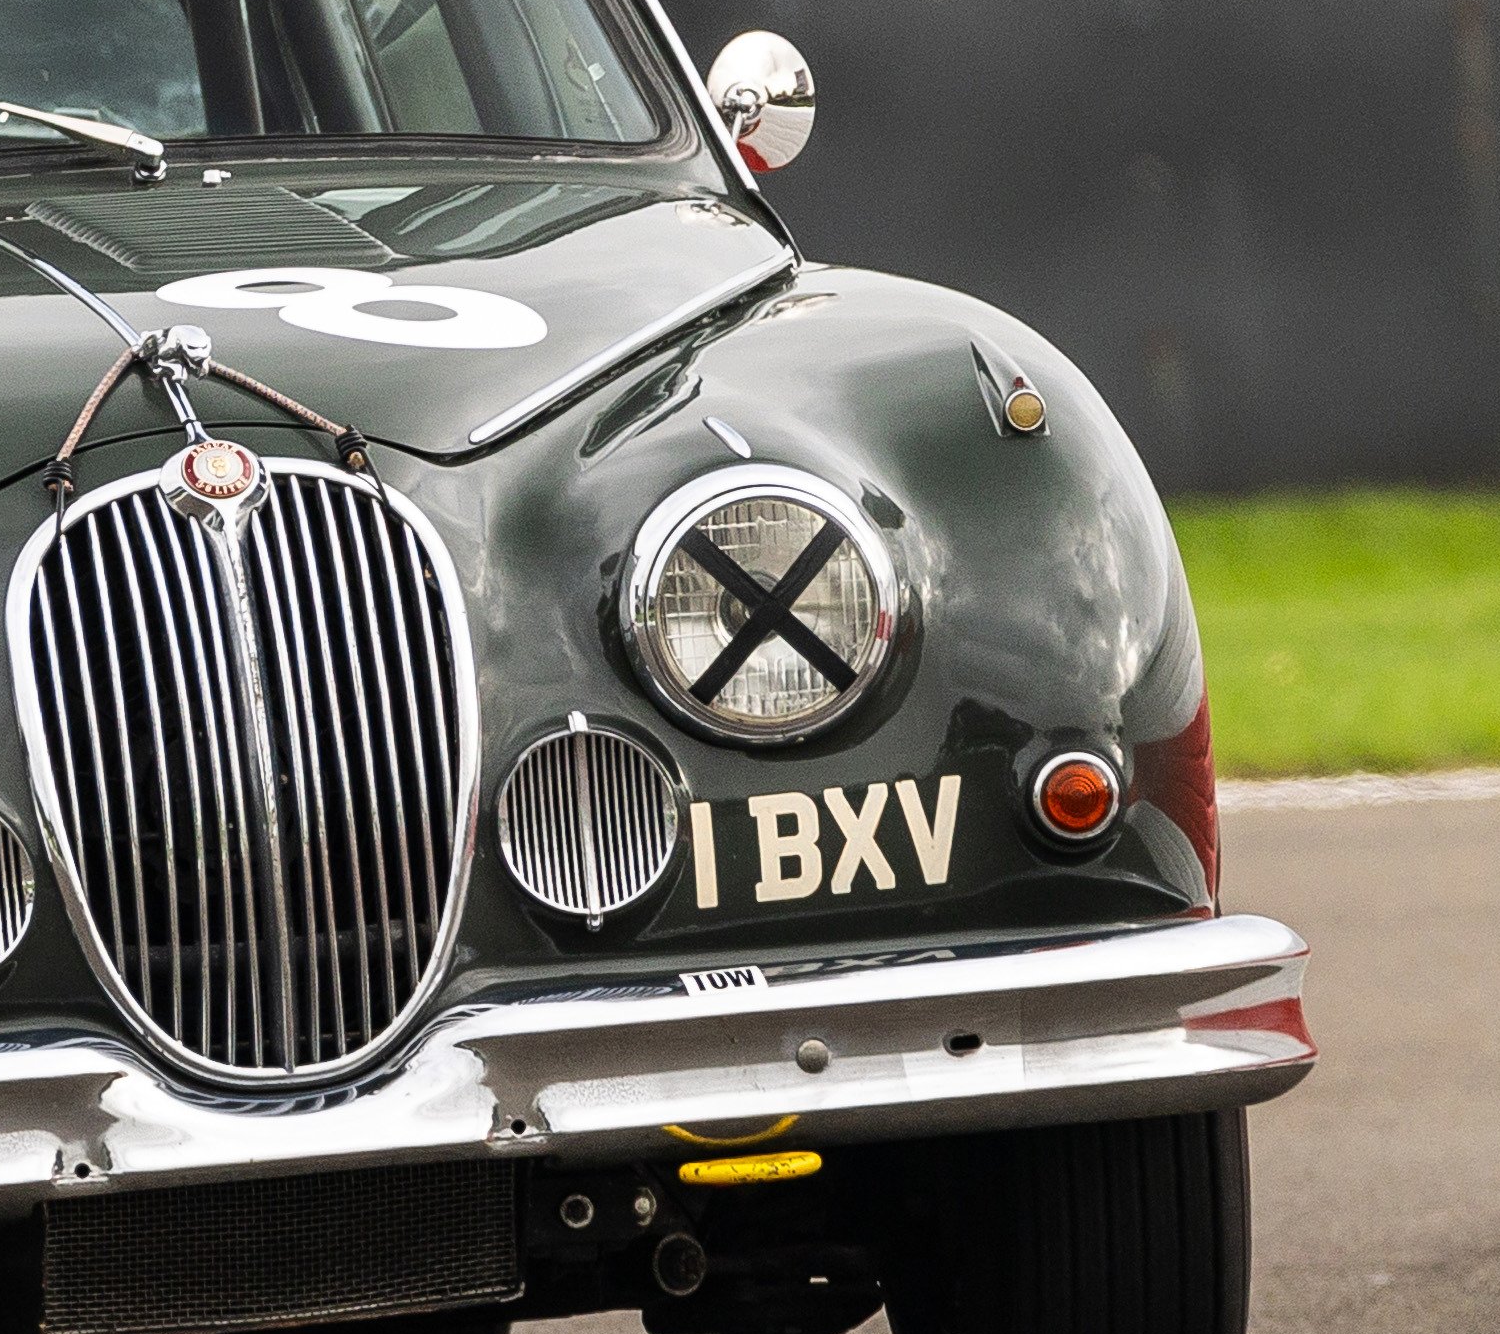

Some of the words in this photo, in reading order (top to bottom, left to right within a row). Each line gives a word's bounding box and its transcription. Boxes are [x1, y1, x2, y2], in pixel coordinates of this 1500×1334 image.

[156, 267, 548, 349] 8
[190, 441, 238, 458] JAGUAR
[687, 968, 756, 991] TOW
